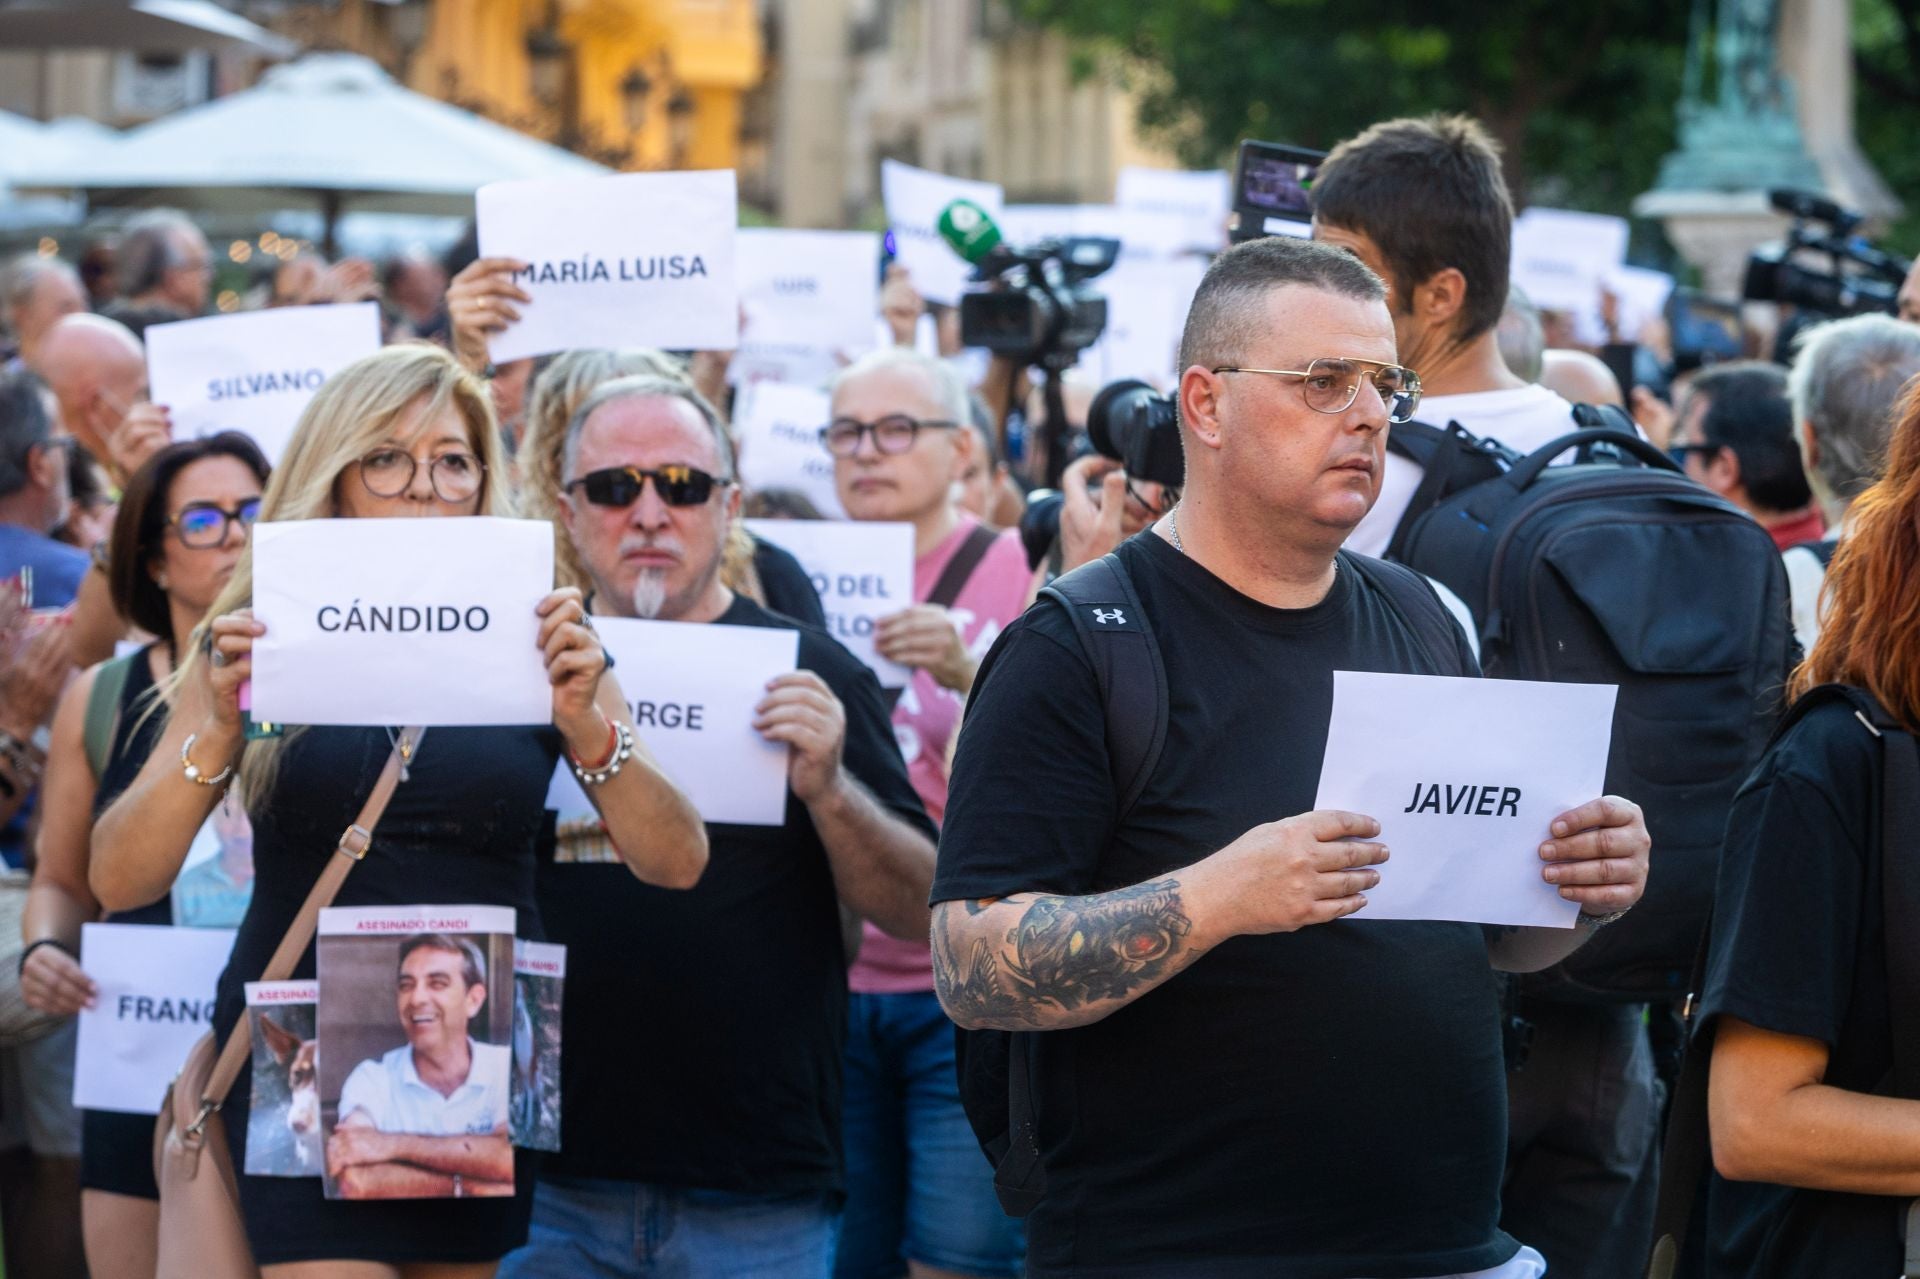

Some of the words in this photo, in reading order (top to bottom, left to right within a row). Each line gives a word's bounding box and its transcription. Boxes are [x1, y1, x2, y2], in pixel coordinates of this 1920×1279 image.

[511, 253, 609, 284] MARÍA
[619, 255, 708, 281] LUISA
[206, 368, 325, 401] SILVANO
[838, 573, 891, 599] DEL
[317, 598, 490, 633] CÁNDIDO
[627, 700, 704, 731] RGE
[1403, 782, 1522, 818] JAVIER
[356, 919, 426, 931] ASESINADO
[428, 918, 470, 930] CANDI
